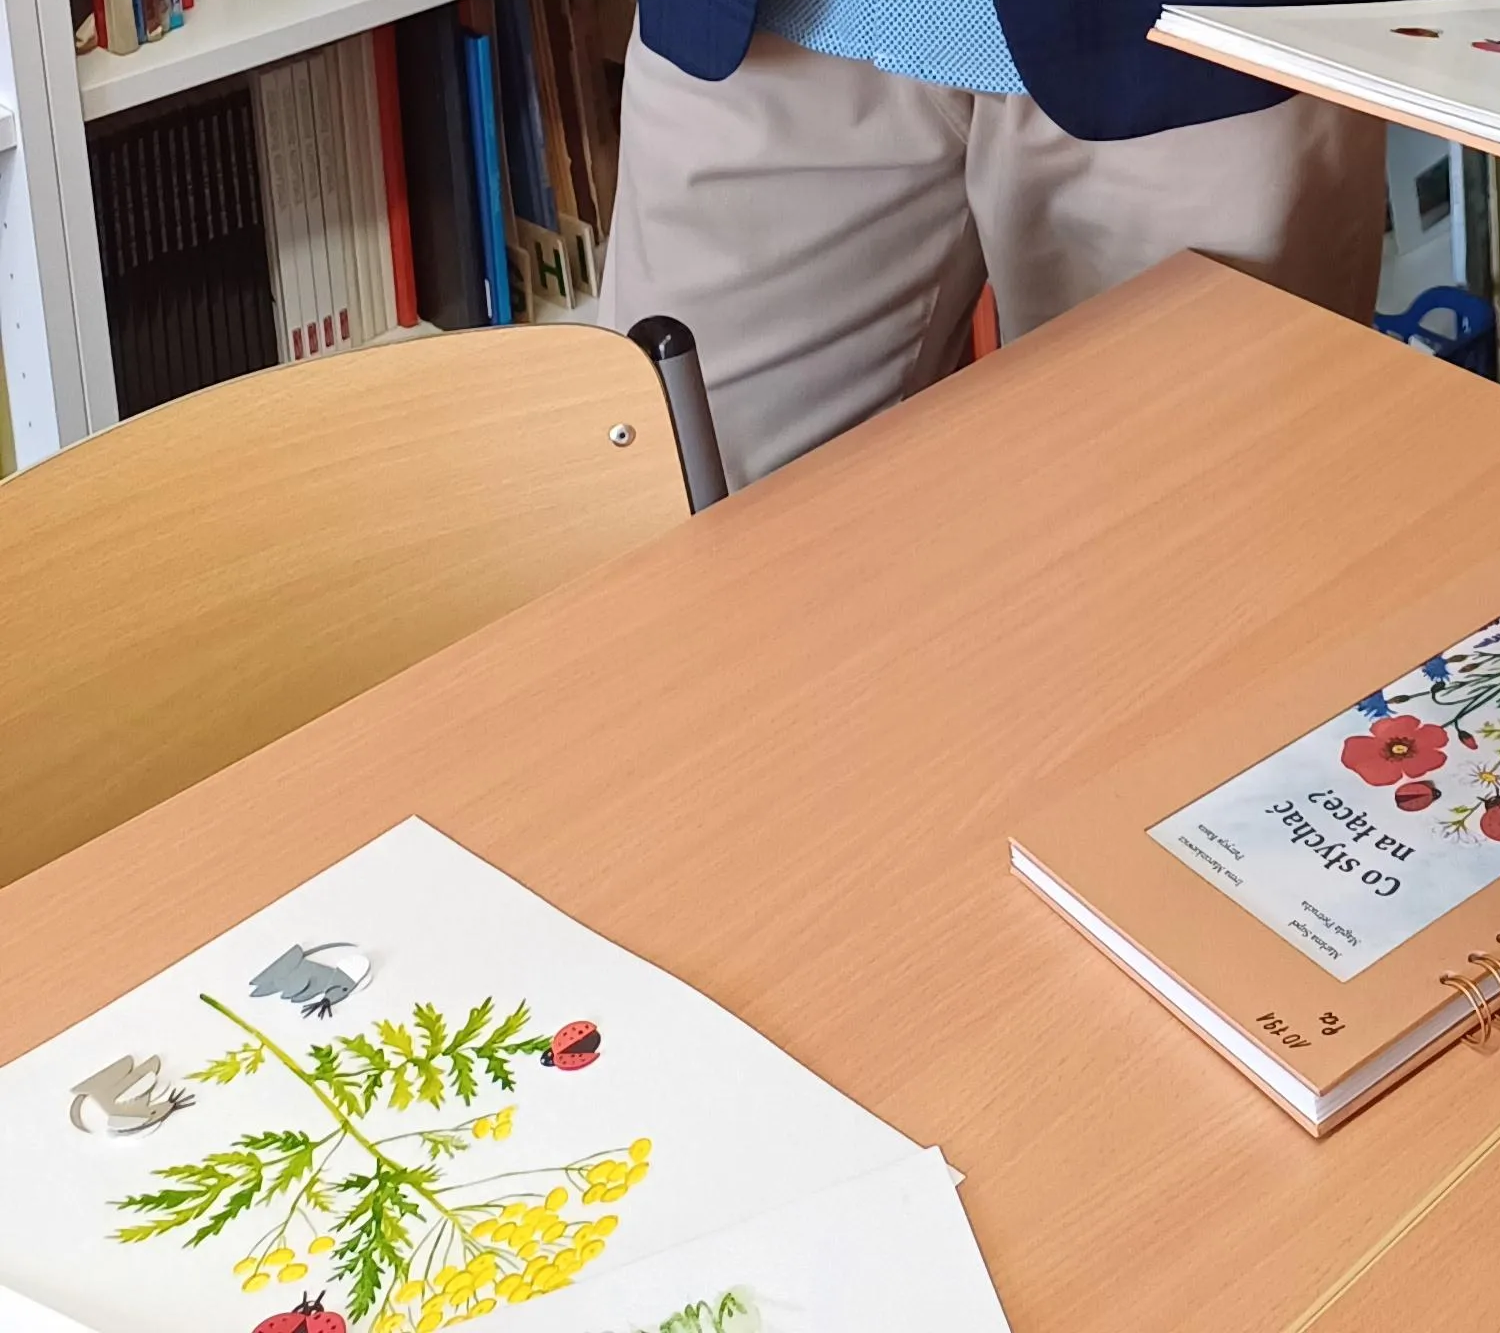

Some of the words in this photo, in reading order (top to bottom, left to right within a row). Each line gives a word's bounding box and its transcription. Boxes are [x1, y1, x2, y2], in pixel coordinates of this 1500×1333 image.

[534, 239, 567, 299] H
[1265, 800, 1360, 873] słychać
[1308, 789, 1377, 842] łące?
[1375, 835, 1416, 861] na
[1362, 870, 1400, 896] Co
